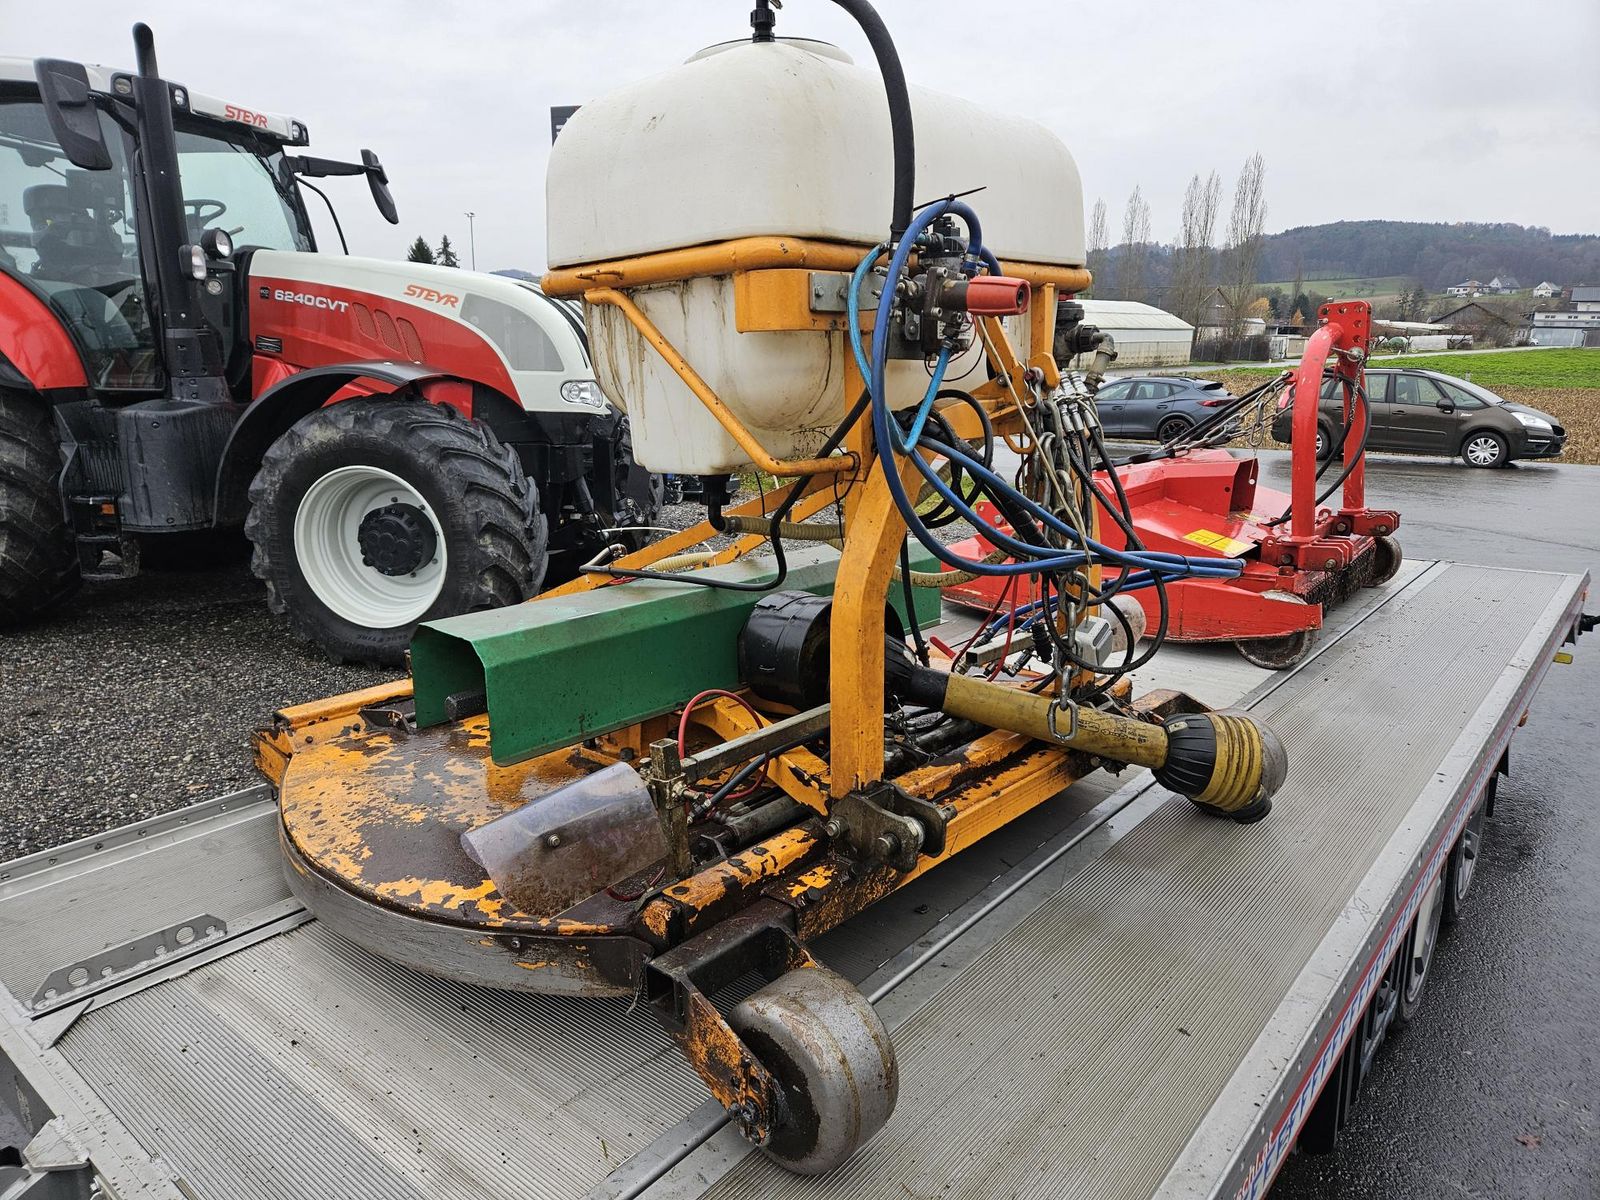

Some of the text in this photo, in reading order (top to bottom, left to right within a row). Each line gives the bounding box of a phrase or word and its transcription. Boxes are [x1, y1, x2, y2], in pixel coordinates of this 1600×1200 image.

[224, 104, 268, 129] STEYR
[273, 289, 349, 313] 6240CVT
[403, 284, 459, 308] STEYR
